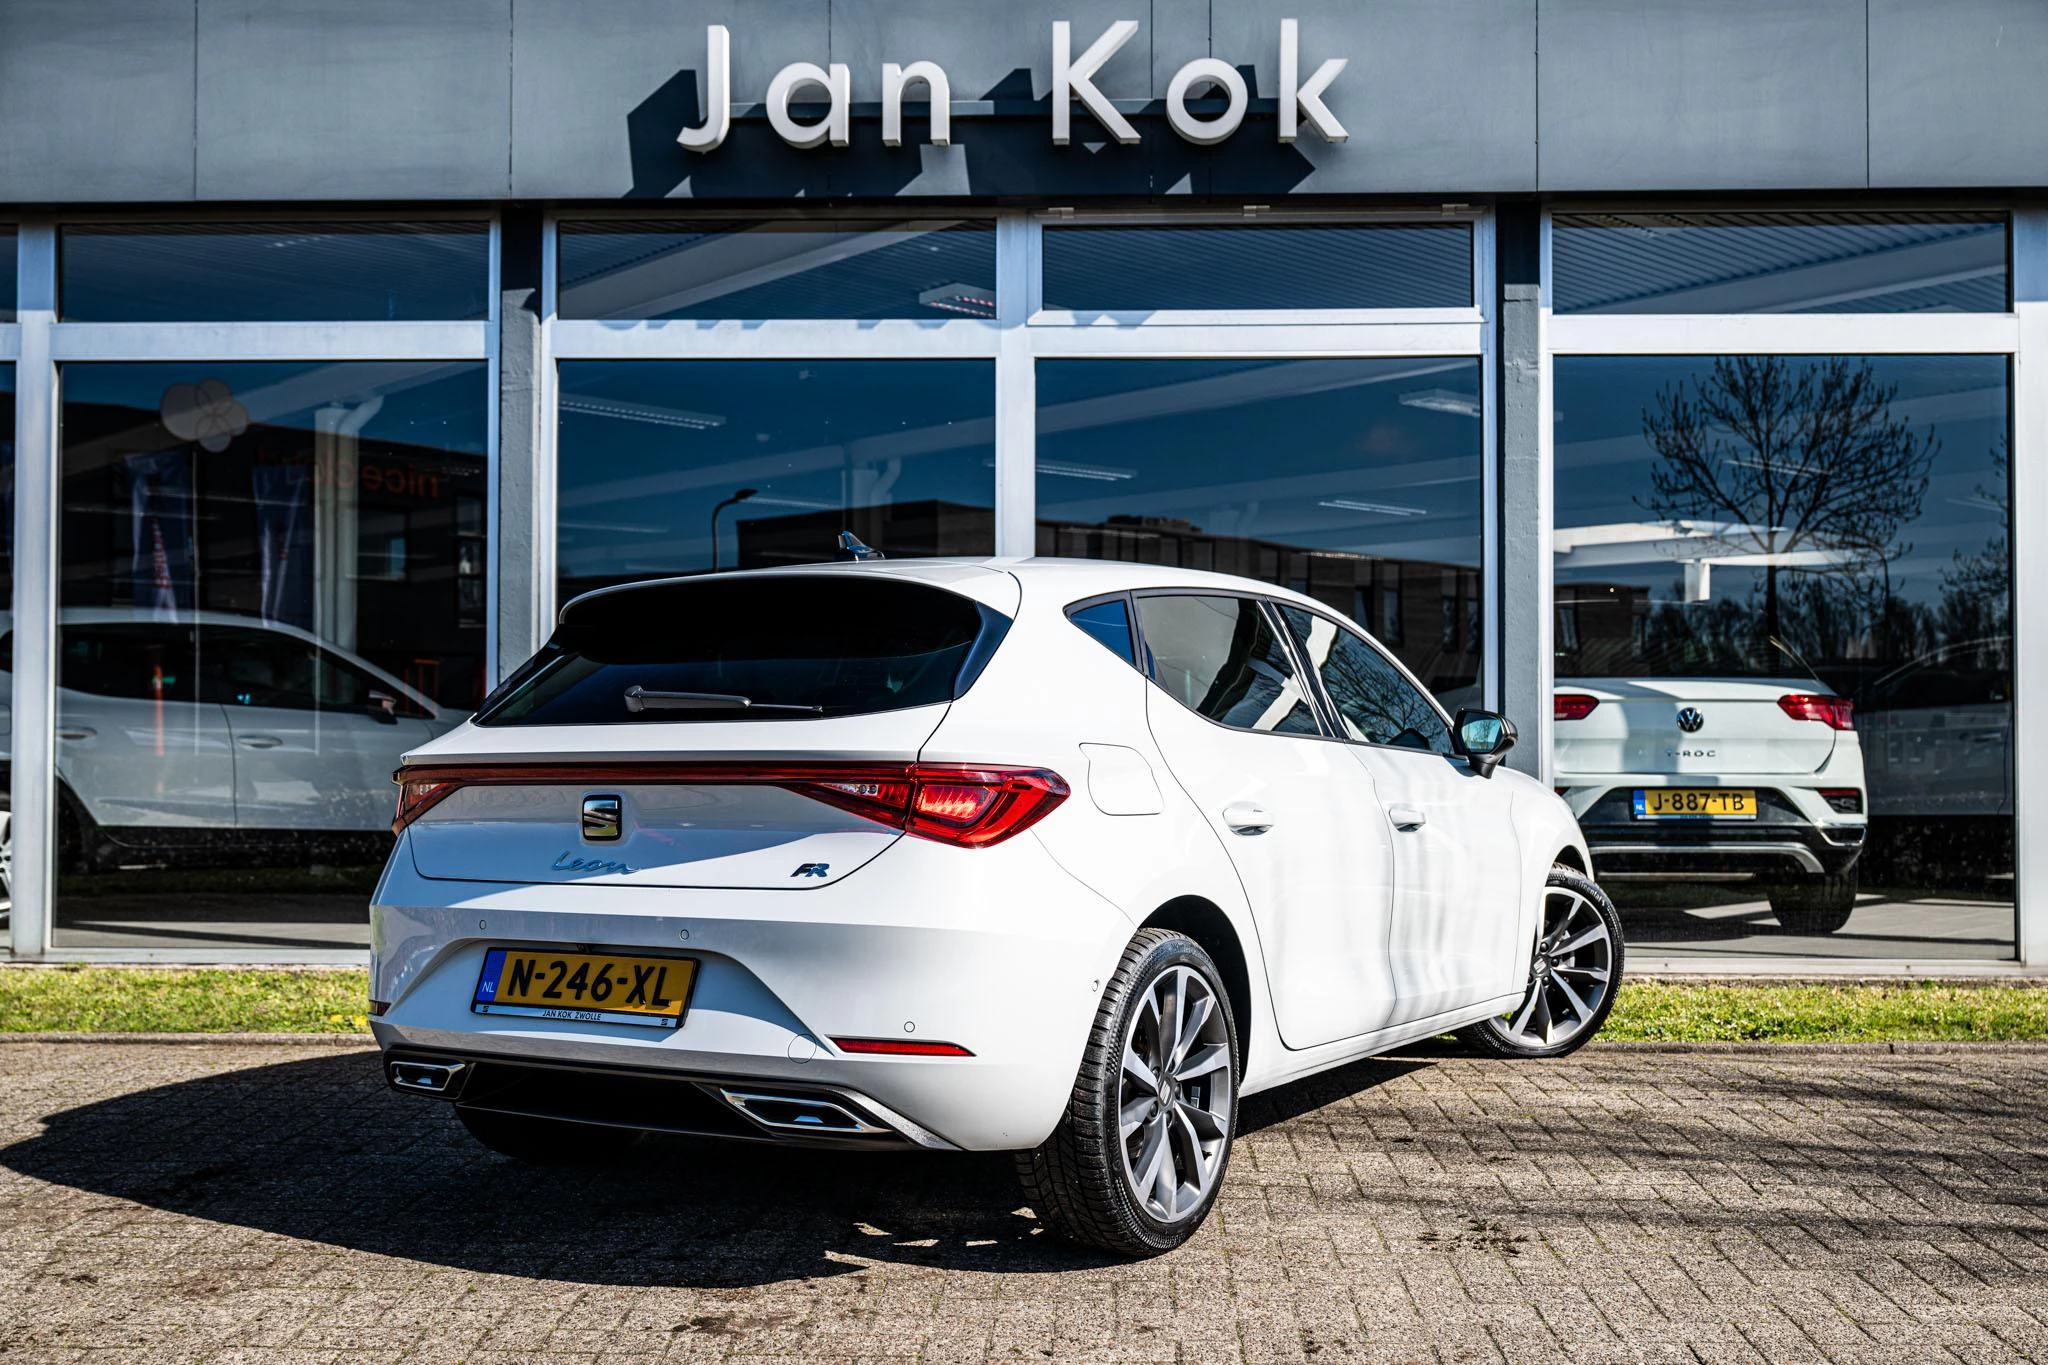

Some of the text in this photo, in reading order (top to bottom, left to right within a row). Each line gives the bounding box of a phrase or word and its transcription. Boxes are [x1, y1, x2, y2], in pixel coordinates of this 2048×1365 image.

[676, 18, 1349, 153] Jan Kok
[1653, 793, 1745, 811] J-887-TB
[551, 850, 641, 875] Leon
[790, 862, 830, 878] FR
[481, 980, 495, 993] NL
[507, 958, 673, 1006] N-246-XL
[542, 1010, 601, 1021] JAN KOK ZWOLLE
